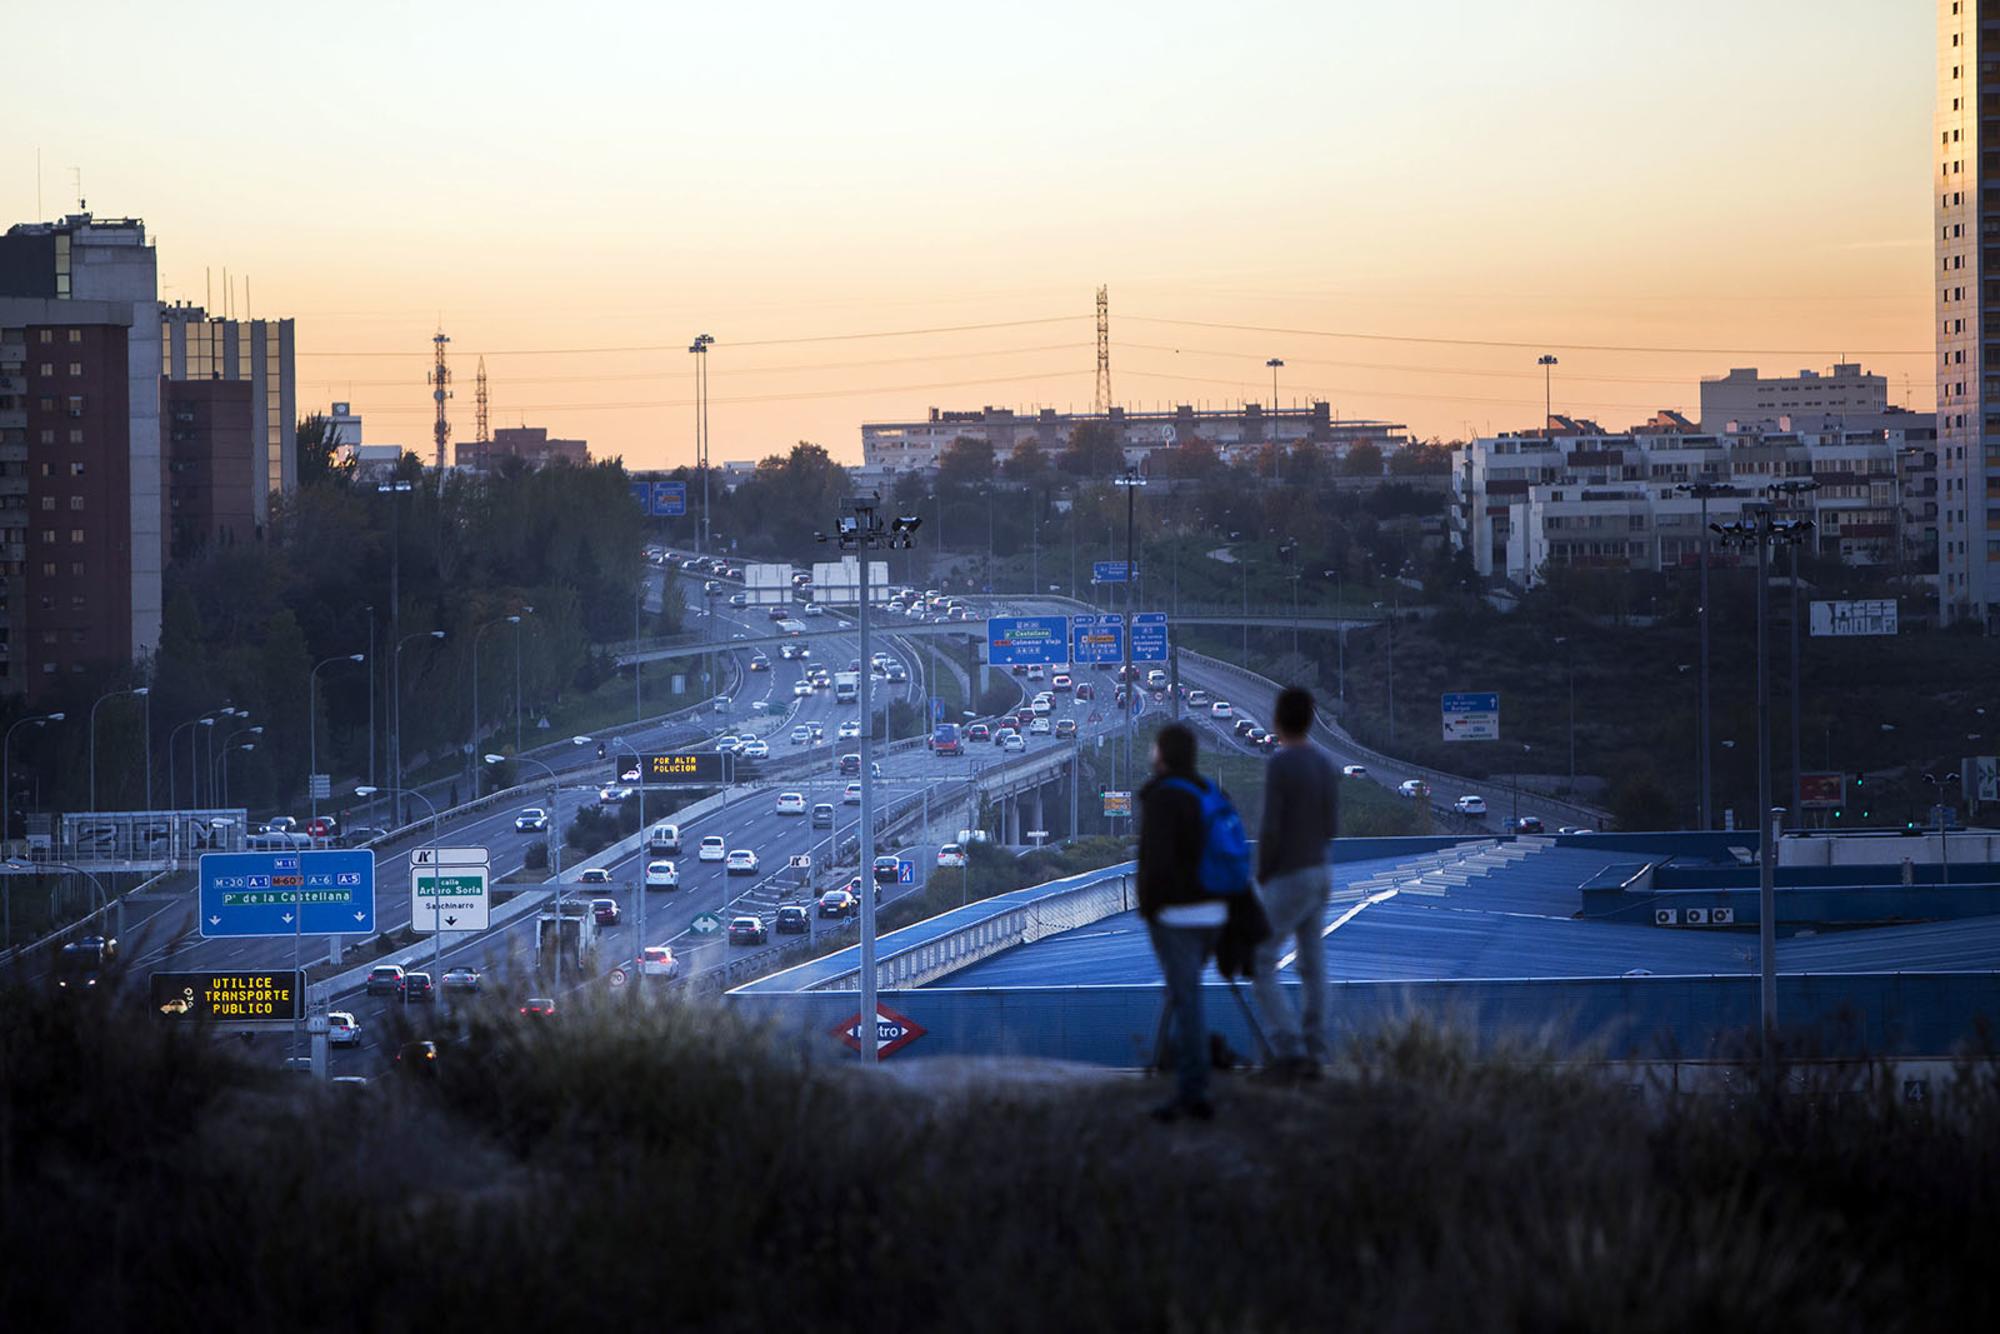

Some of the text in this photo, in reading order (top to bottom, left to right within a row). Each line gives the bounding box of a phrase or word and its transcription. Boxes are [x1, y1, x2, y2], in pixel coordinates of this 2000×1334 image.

[653, 756, 697, 765] POR ALTA
[653, 765, 697, 773] POLUCION
[215, 877, 244, 888] M-30
[249, 877, 268, 887] A-1
[309, 876, 330, 885] A-6
[339, 874, 358, 884] A-5
[455, 885, 481, 895] Soria
[243, 893, 257, 903] de
[263, 892, 275, 902] la
[213, 977, 272, 989] UTILICE
[204, 989, 289, 1001] TRANSPORTE
[213, 1003, 272, 1014] PUBLICO
